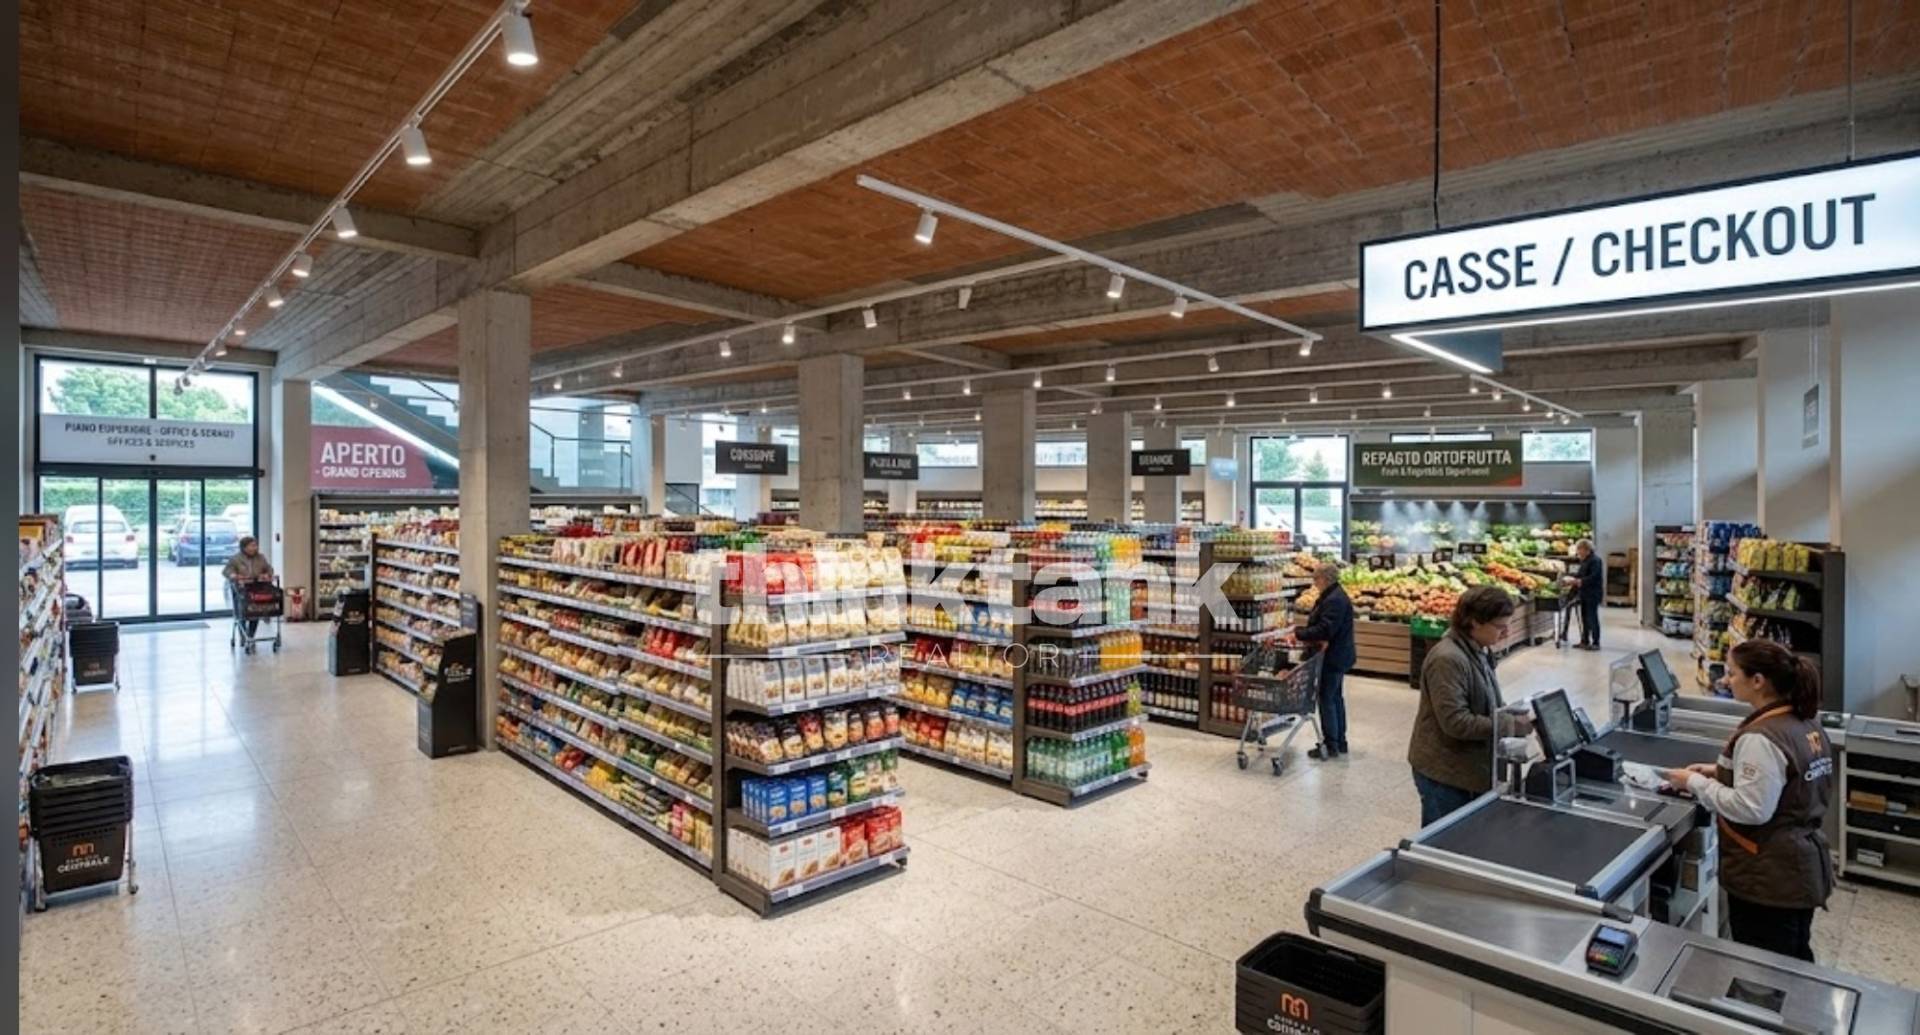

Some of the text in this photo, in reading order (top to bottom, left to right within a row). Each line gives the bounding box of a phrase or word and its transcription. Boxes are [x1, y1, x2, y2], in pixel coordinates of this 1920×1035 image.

[1404, 193, 1877, 301] CASSE / CHECKOUT
[65, 422, 97, 433] PIANO
[320, 441, 405, 466] APERTO
[1423, 449, 1512, 466] ORTOFRUTTA
